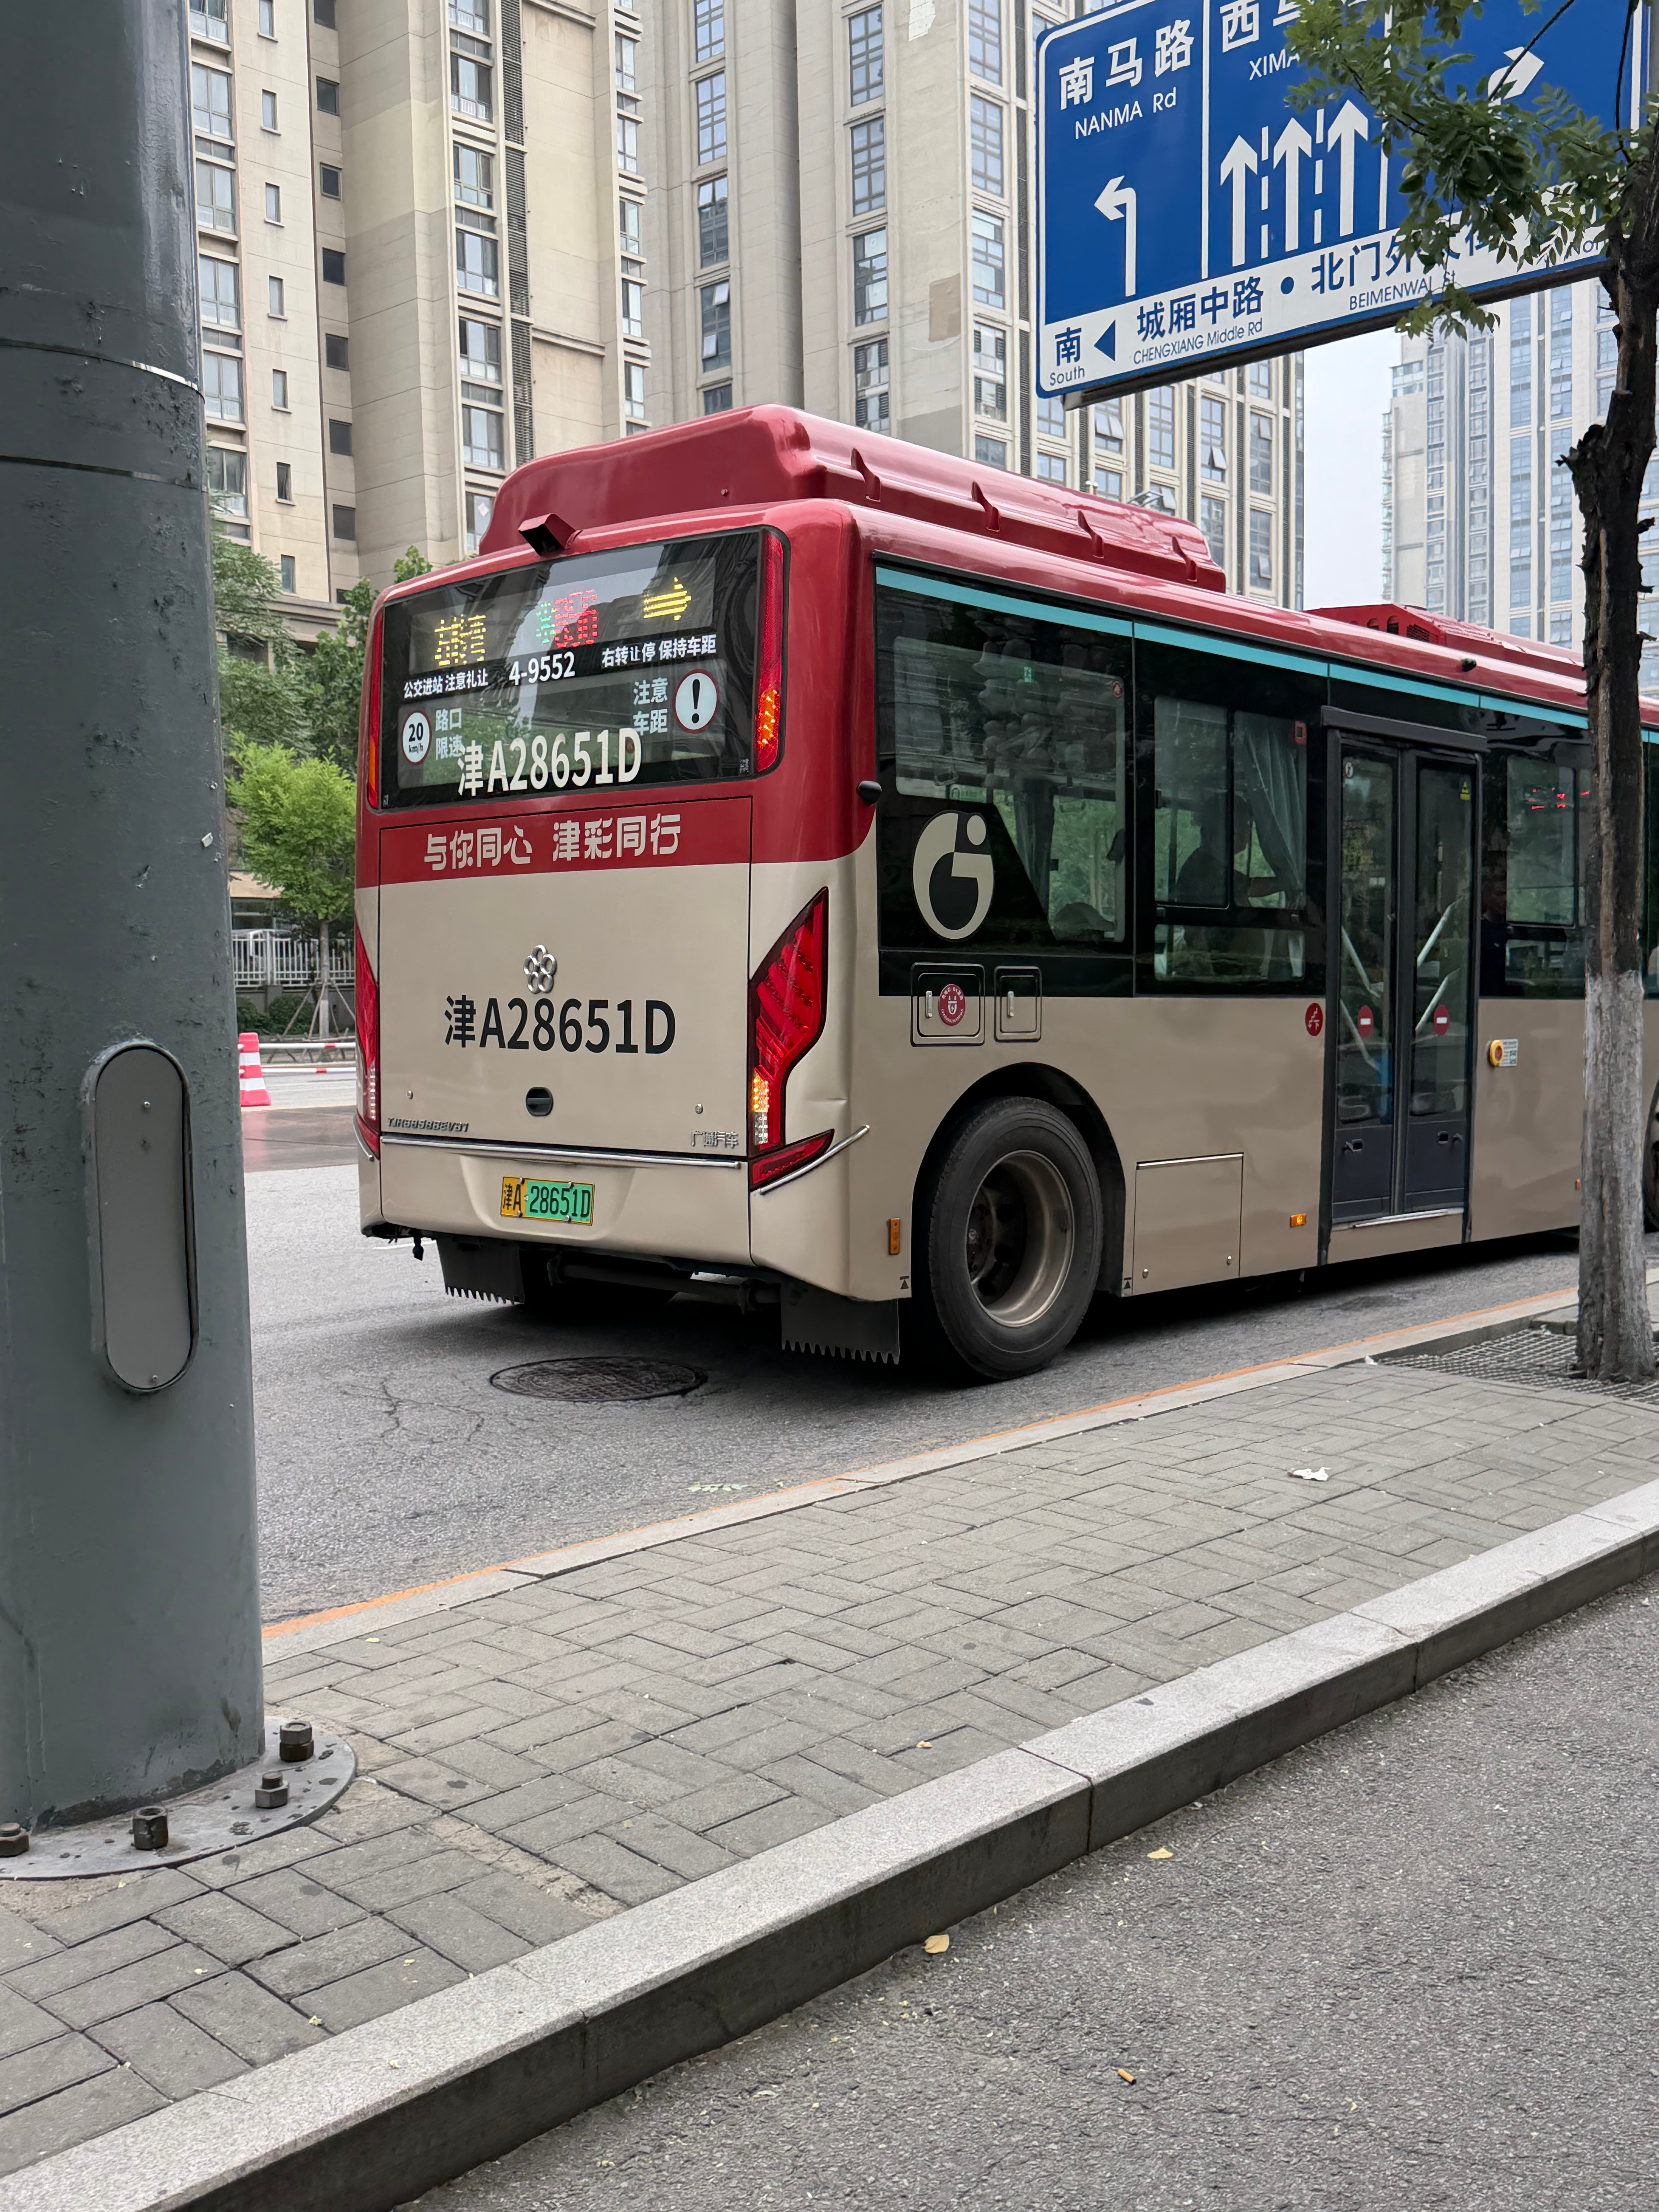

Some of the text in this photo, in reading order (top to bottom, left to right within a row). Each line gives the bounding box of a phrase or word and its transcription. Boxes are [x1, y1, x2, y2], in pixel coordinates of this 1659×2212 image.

[1059, 19, 1194, 110] 南马路
[1075, 87, 1176, 139] NANMA Rd
[1137, 276, 1264, 342] 城厢中路
[1350, 276, 1432, 311] BEIMENWAI
[1055, 326, 1082, 366] 南
[1133, 318, 1262, 364] CHENGXIANG Middle Rd
[1050, 366, 1085, 386] South
[509, 651, 575, 686] 4-9552
[602, 634, 716, 668] 右转让停 保持车距
[404, 668, 488, 698] 公交进站 注意礼让
[633, 677, 668, 705] 注意
[409, 722, 424, 742] 20
[435, 708, 462, 731] 路口
[633, 709, 668, 736] 车距
[436, 734, 463, 760] 限速
[457, 728, 641, 797] 津A28651D
[424, 813, 680, 871] 与你同心 津彩同行
[445, 994, 675, 1054] 津A28651D
